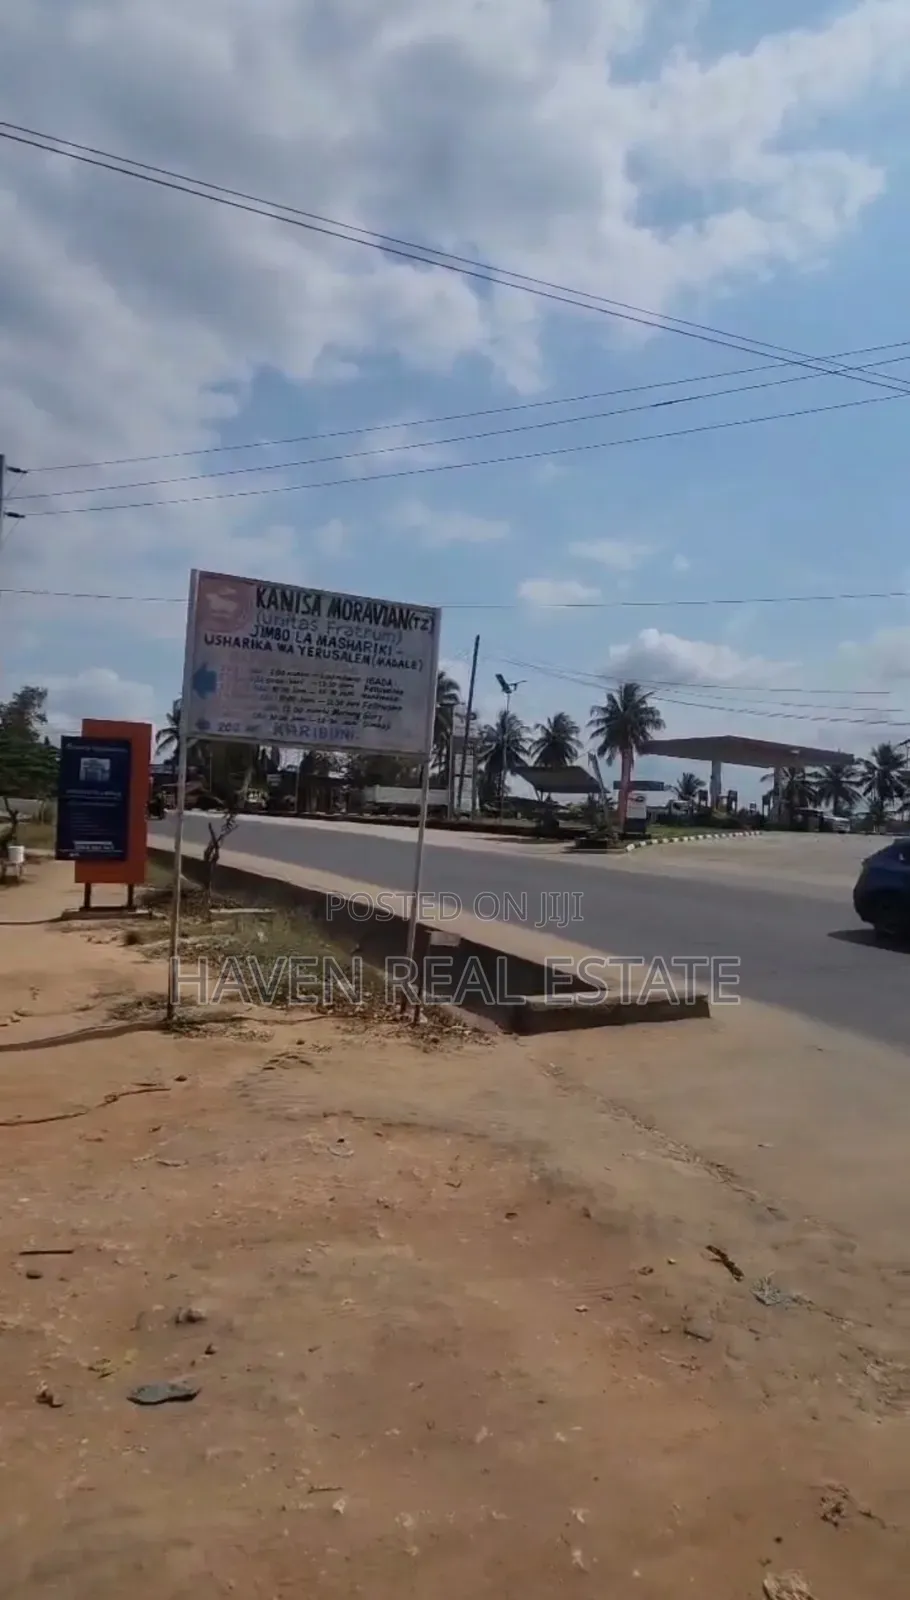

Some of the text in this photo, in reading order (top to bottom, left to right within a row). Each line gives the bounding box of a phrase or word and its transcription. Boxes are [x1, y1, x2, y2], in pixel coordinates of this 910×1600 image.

[255, 586, 322, 617] KANISA
[204, 633, 273, 652] USHARIKA
[277, 642, 294, 654] WA
[249, 624, 290, 642] JIMBO
[295, 632, 312, 645] LA
[316, 633, 392, 655] MASHARIKI
[326, 622, 404, 645] Fratrum)
